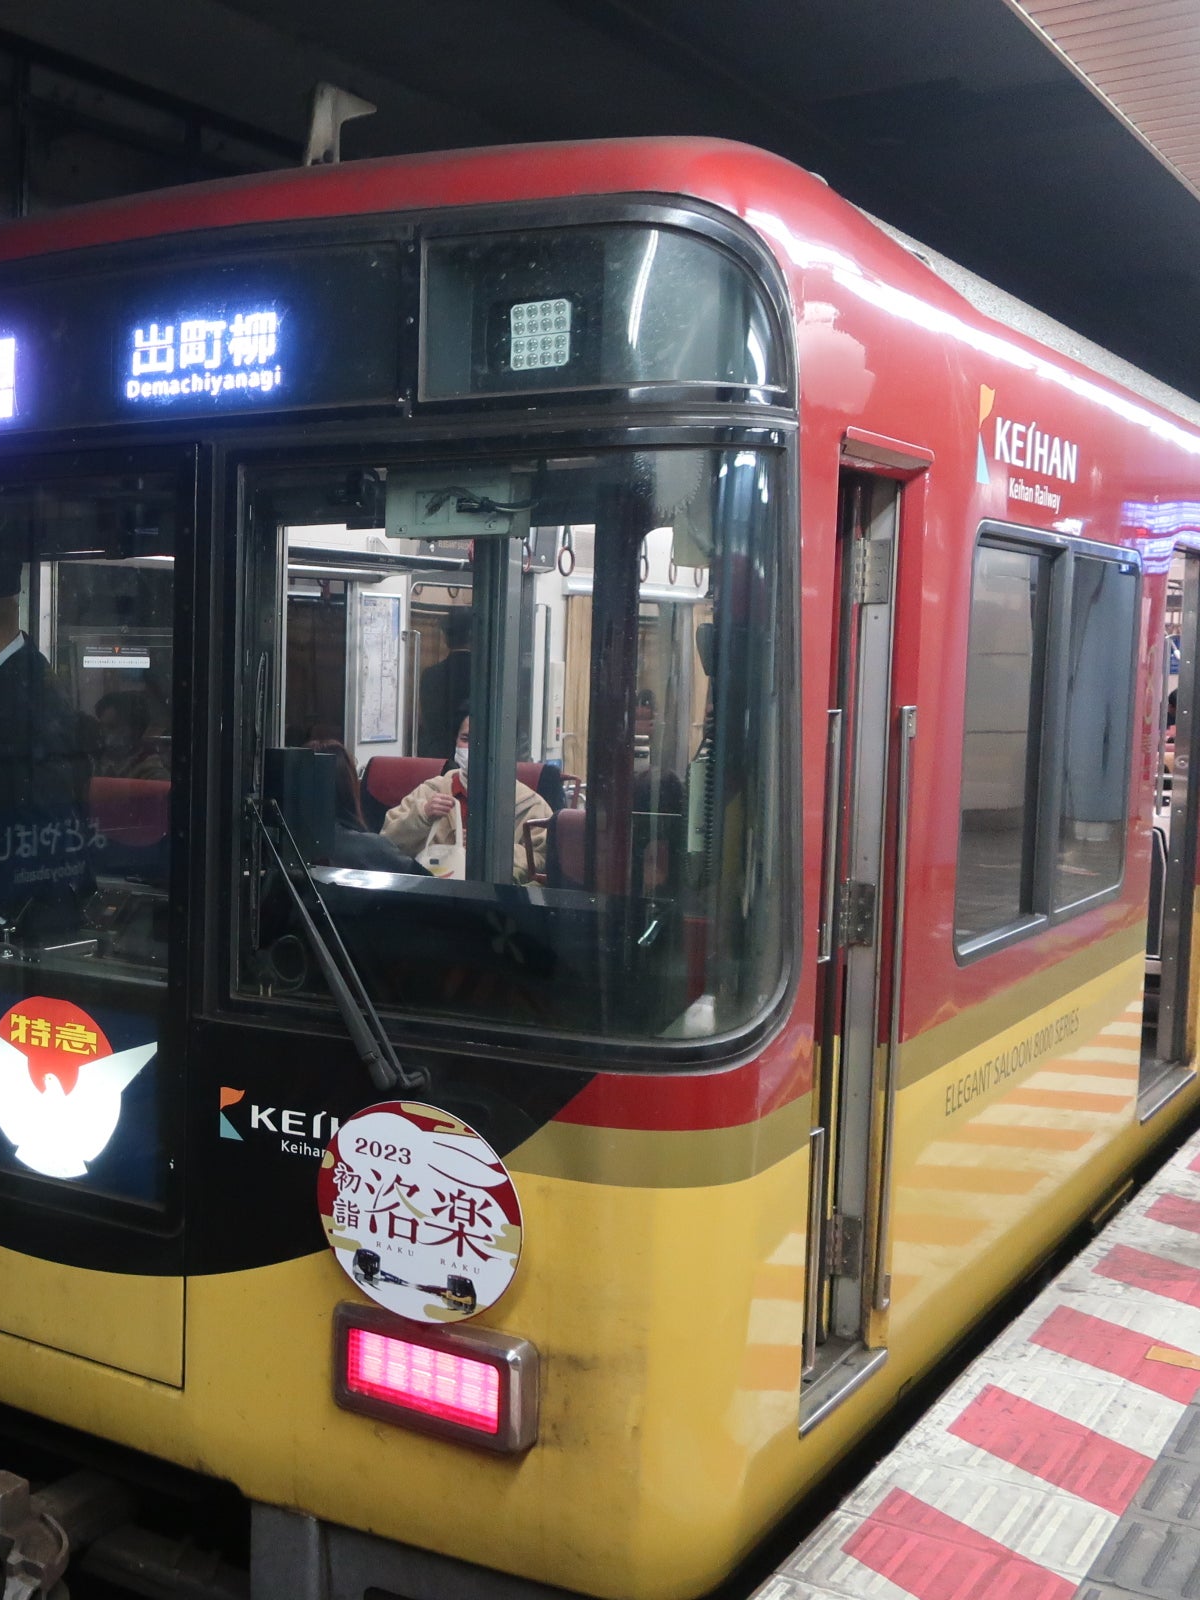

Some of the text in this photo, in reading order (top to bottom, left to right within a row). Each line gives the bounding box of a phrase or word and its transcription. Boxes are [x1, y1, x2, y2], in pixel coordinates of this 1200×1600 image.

[132, 312, 277, 377] 出町柳
[126, 364, 282, 398] Demachiyanagi
[994, 416, 1078, 484] KEIHAN
[1008, 477, 1061, 515] Keihan Railway
[10, 1013, 98, 1056] 特急
[945, 1060, 993, 1117] ELEGANT
[993, 1034, 1033, 1086] SALOON
[1054, 1007, 1081, 1046] SERIES
[355, 1137, 412, 1165] 2023
[334, 1163, 362, 1230] 初詣
[375, 1240, 415, 1258] RAKU
[439, 1257, 481, 1276] RAKU
